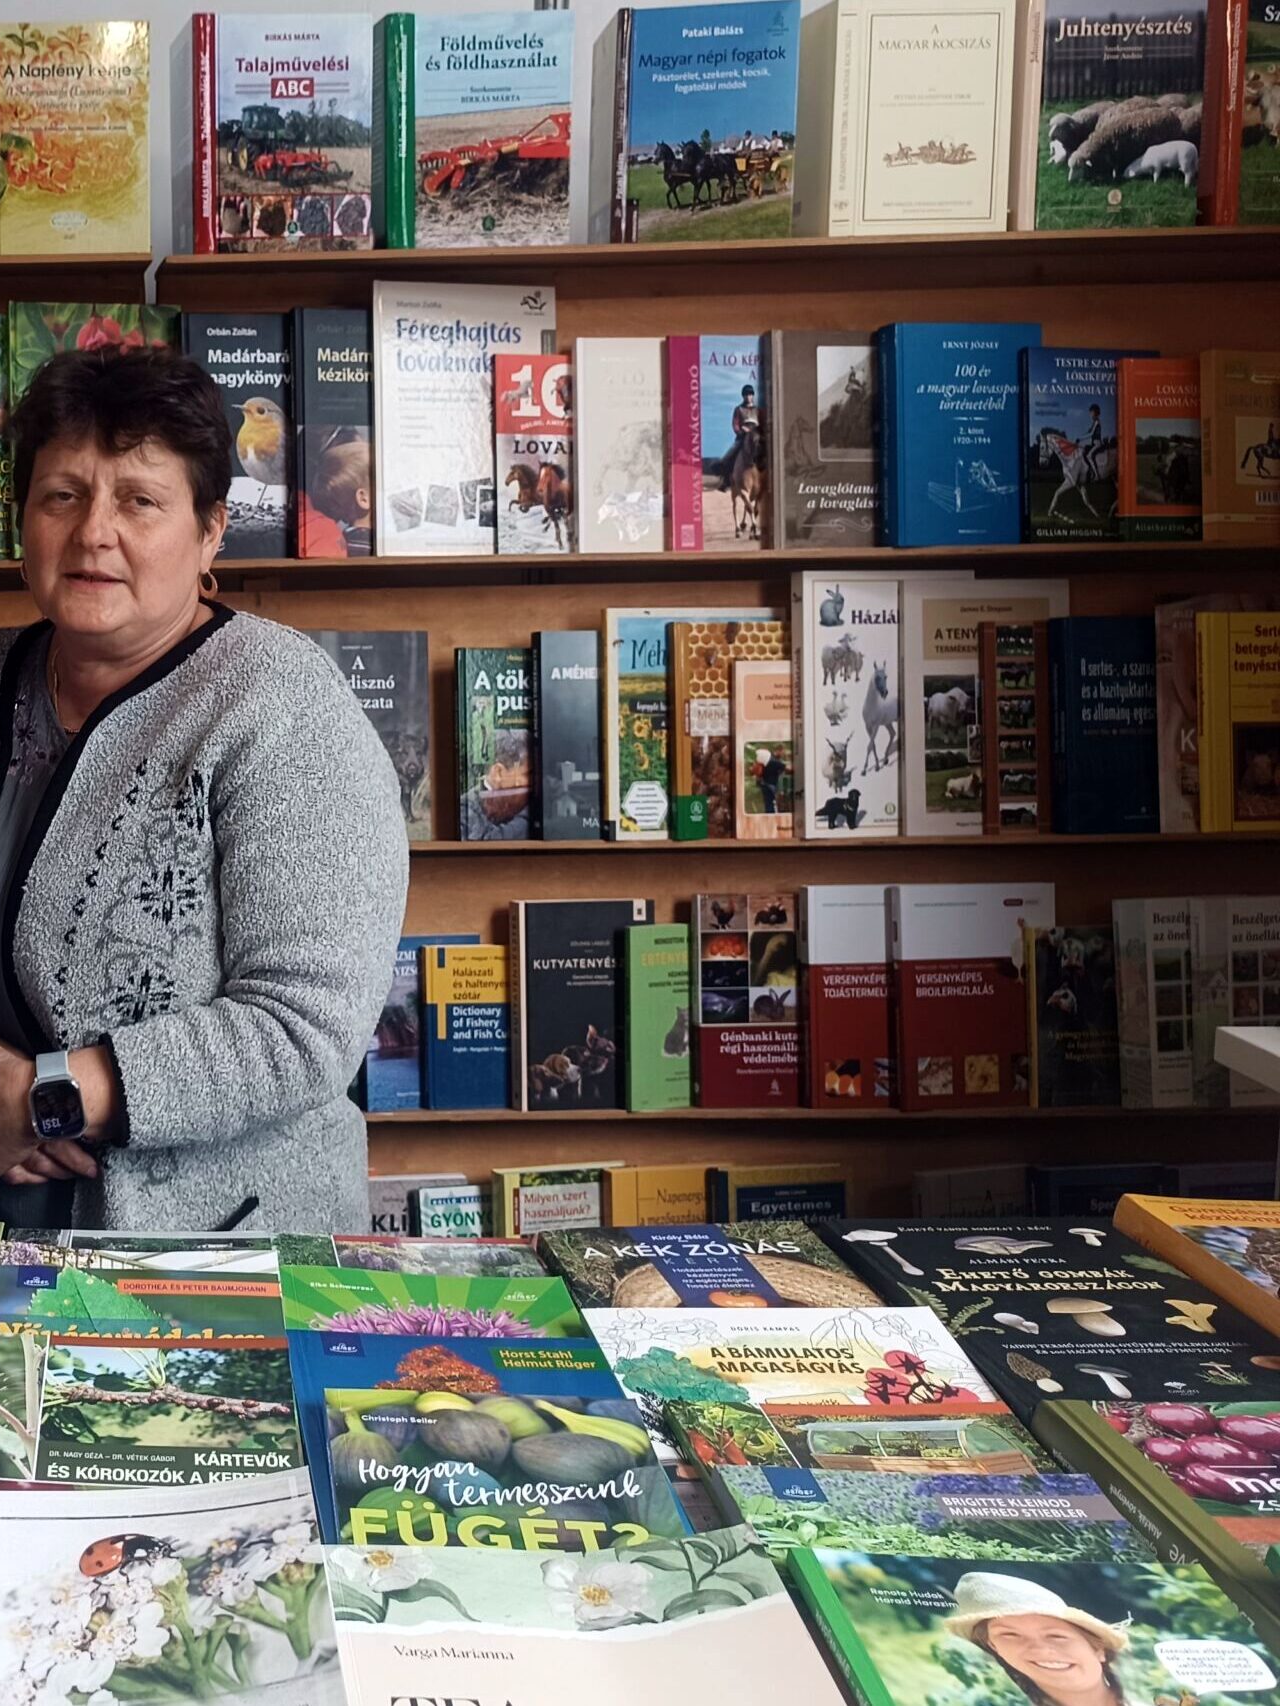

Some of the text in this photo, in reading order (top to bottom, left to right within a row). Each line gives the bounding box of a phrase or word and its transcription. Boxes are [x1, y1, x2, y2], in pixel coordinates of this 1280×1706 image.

[683, 26, 743, 38] Pataki Balázs
[931, 24, 939, 34] A
[1055, 16, 1192, 42] Juhtenyésztés
[265, 33, 289, 41] BIRKÁS
[441, 36, 544, 51] Földművelés
[879, 37, 991, 50] MAGYAR KOCSIZÁS
[426, 52, 558, 70] és földhasználat
[638, 45, 786, 70] Magyar népi fogatok
[236, 56, 349, 74] Talajművelési
[4, 64, 84, 81] A Napfény
[652, 69, 740, 82] Pásztorélet, szekerek,
[275, 79, 310, 96] ABC
[675, 79, 747, 94] fogatolási módok
[207, 327, 256, 336] Orbán Zoltán
[397, 319, 521, 350] Féreghajtás
[943, 340, 999, 350] ERNST JÓZSEF
[709, 352, 718, 366] A
[1055, 357, 1088, 368] TESTRE
[955, 364, 991, 378] 100 év
[917, 383, 966, 398] a magyar
[1035, 384, 1047, 394] AZ
[940, 395, 1006, 411] történetéből
[689, 365, 700, 466] TANÁCSADÓ
[807, 499, 815, 509] a
[1037, 527, 1102, 537] GILLIAN HIGGINS
[935, 628, 944, 639] A
[352, 656, 365, 670] A
[551, 668, 560, 680] A
[475, 674, 490, 690] A
[453, 967, 493, 980] Halászati
[916, 971, 982, 984] VERSENYKÉPES
[453, 980, 464, 989] és
[916, 984, 994, 998] BROJLERHIZLALÁS
[454, 990, 480, 1000] szótár
[453, 1006, 501, 1020] Dictionary
[454, 1018, 499, 1031] of Fishery
[454, 1028, 492, 1040] and Fish
[720, 1032, 770, 1045] Génbanki
[720, 1043, 741, 1055] régi
[524, 1191, 586, 1206] Milyen szert
[524, 1205, 591, 1219] használjunk?
[751, 1200, 832, 1214] Egyetemes
[651, 1233, 682, 1243] Király
[584, 1239, 801, 1259] A KÉK ZÓNÁS
[123, 1282, 266, 1294] DOROTHEA ÉS PETER BAUMJOHANN
[499, 1350, 572, 1359] Horst Stahl
[711, 1344, 854, 1360] A BÁMULATOS
[504, 1359, 595, 1369] Helmut Rüger
[717, 1359, 865, 1375] MAGASÁGYÁS
[362, 1414, 407, 1424] Christoph
[64, 1451, 83, 1459] NAGY
[86, 1450, 103, 1459] GÉZA
[126, 1452, 148, 1461] VÉTEK
[151, 1453, 175, 1462] GÁBOR
[195, 1450, 292, 1467] KÁRTEVŐK
[48, 1463, 184, 1482] ÉS KÓROKOZÓK
[359, 1458, 479, 1494] Hogyan
[444, 1470, 643, 1507] termesszünk
[942, 1497, 1070, 1508] BRIGITTE KLEINOD
[950, 1507, 1087, 1518] MANFRED STIEBLER
[870, 1588, 905, 1598] Renate
[874, 1596, 910, 1606] Harald
[394, 1645, 514, 1660] Varga Marianna
